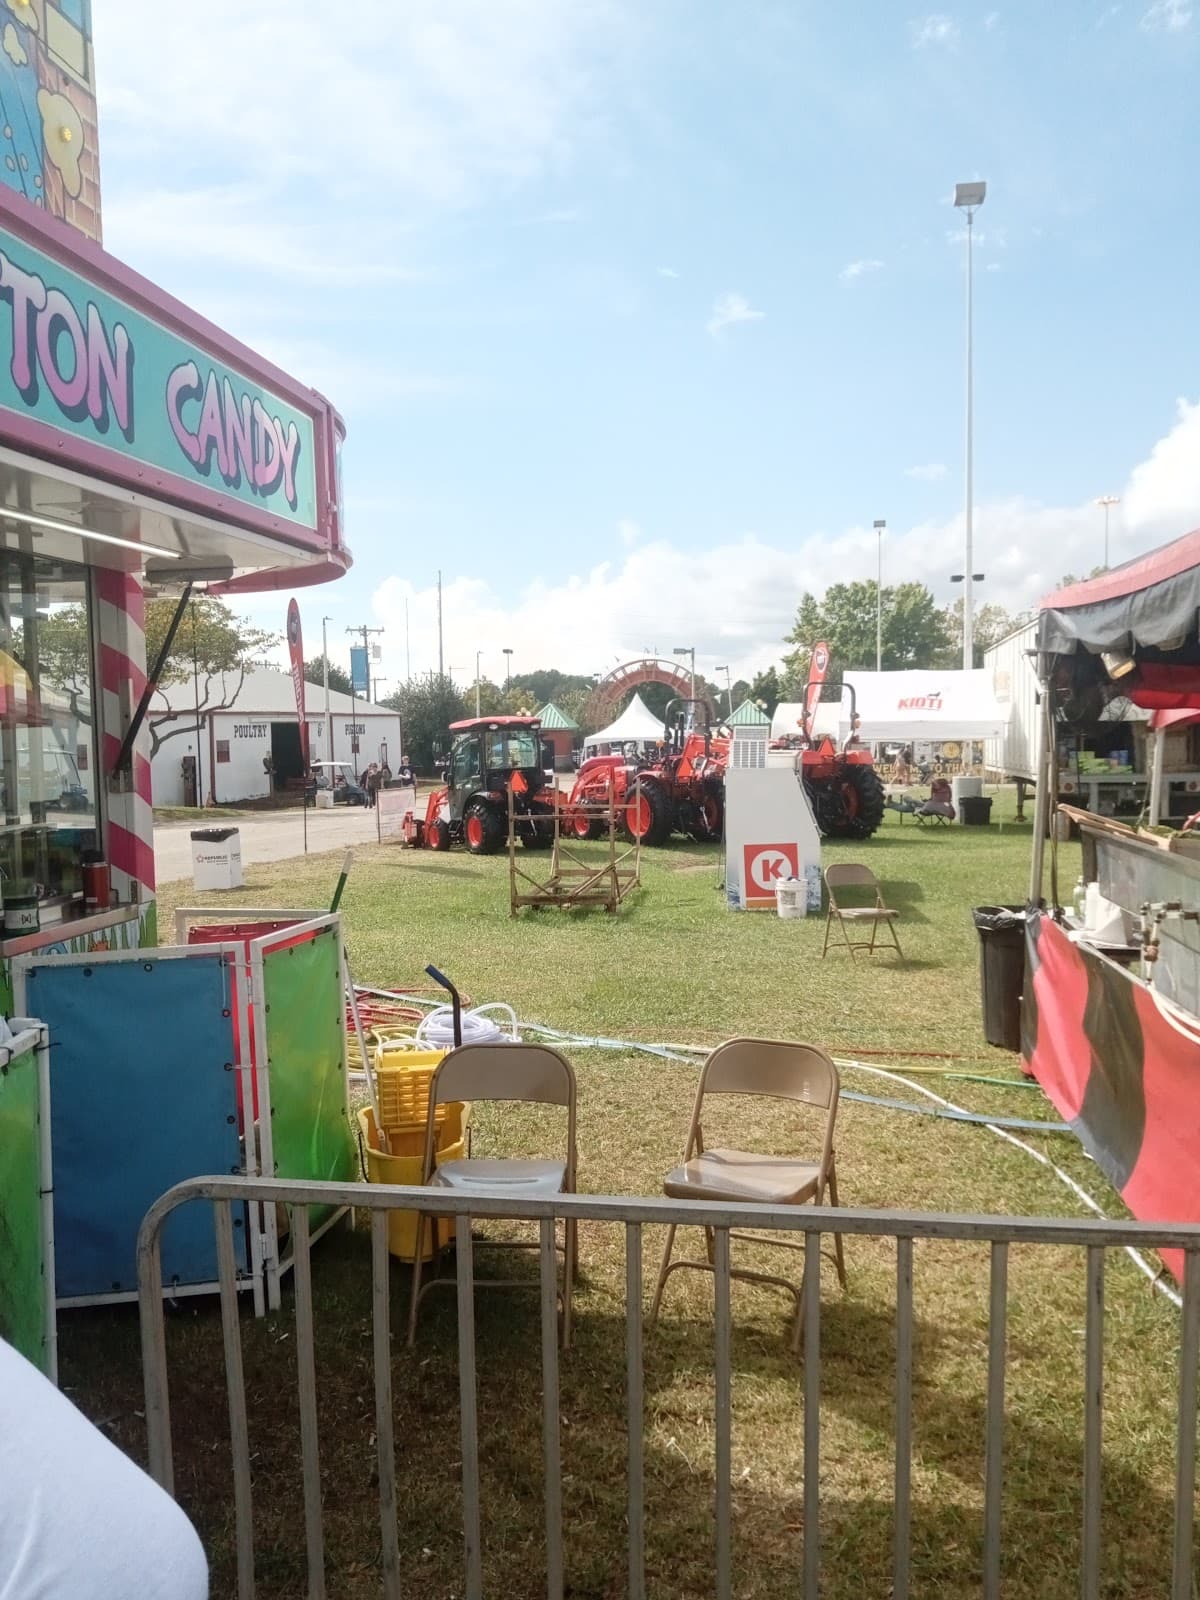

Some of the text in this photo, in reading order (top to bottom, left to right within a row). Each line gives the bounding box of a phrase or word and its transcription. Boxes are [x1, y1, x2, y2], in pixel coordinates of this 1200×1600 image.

[165, 359, 301, 512] CANDY
[898, 697, 943, 711] KIOTI
[233, 724, 267, 739] POULTRY
[872, 763, 922, 774] WELM
[945, 763, 965, 774] TH
[762, 858, 784, 882] K
